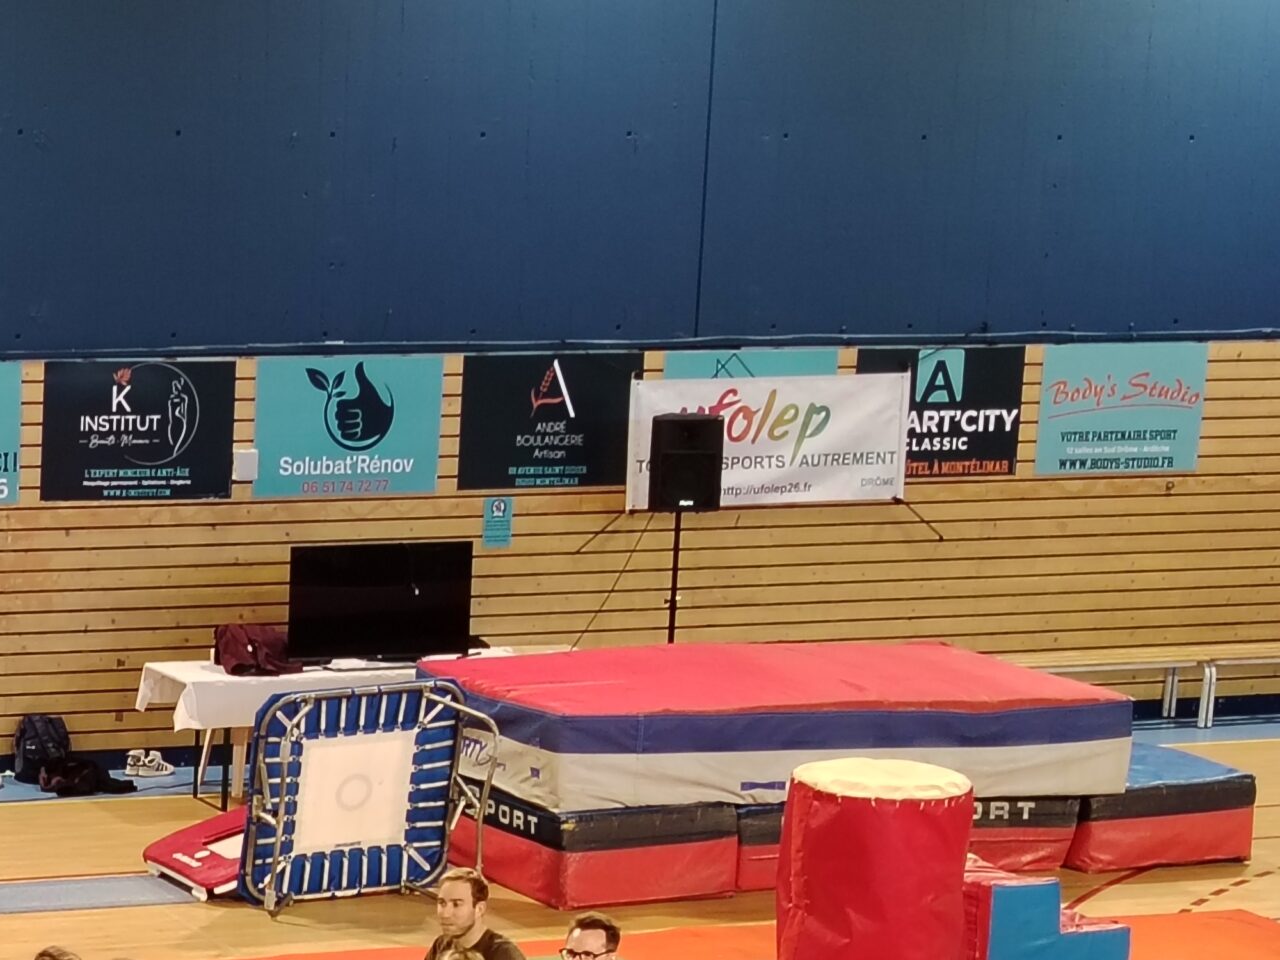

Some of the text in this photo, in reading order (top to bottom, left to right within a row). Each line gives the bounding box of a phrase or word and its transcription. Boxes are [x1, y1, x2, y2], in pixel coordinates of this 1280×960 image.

[1047, 372, 1201, 406] Body's Studio
[112, 385, 131, 412] K
[80, 415, 161, 431] INSTITUT
[535, 420, 566, 433] ANDRÉ
[516, 434, 584, 446] BOULANGERIE
[1061, 429, 1178, 442] VOTRE PARTENAIRE SPORT
[533, 449, 566, 459] Artisan
[721, 451, 897, 470] SPORTS AUTREMENT
[279, 455, 414, 475] Solubat'Rénov
[941, 458, 1009, 474] MONTÉLIMAR
[1058, 457, 1174, 470] WWW.BODYS-STUDIO.FR
[302, 482, 318, 493] 06
[340, 481, 353, 492] 74
[358, 480, 371, 492] 72
[376, 480, 389, 491] 77
[861, 476, 895, 487] DRÔME
